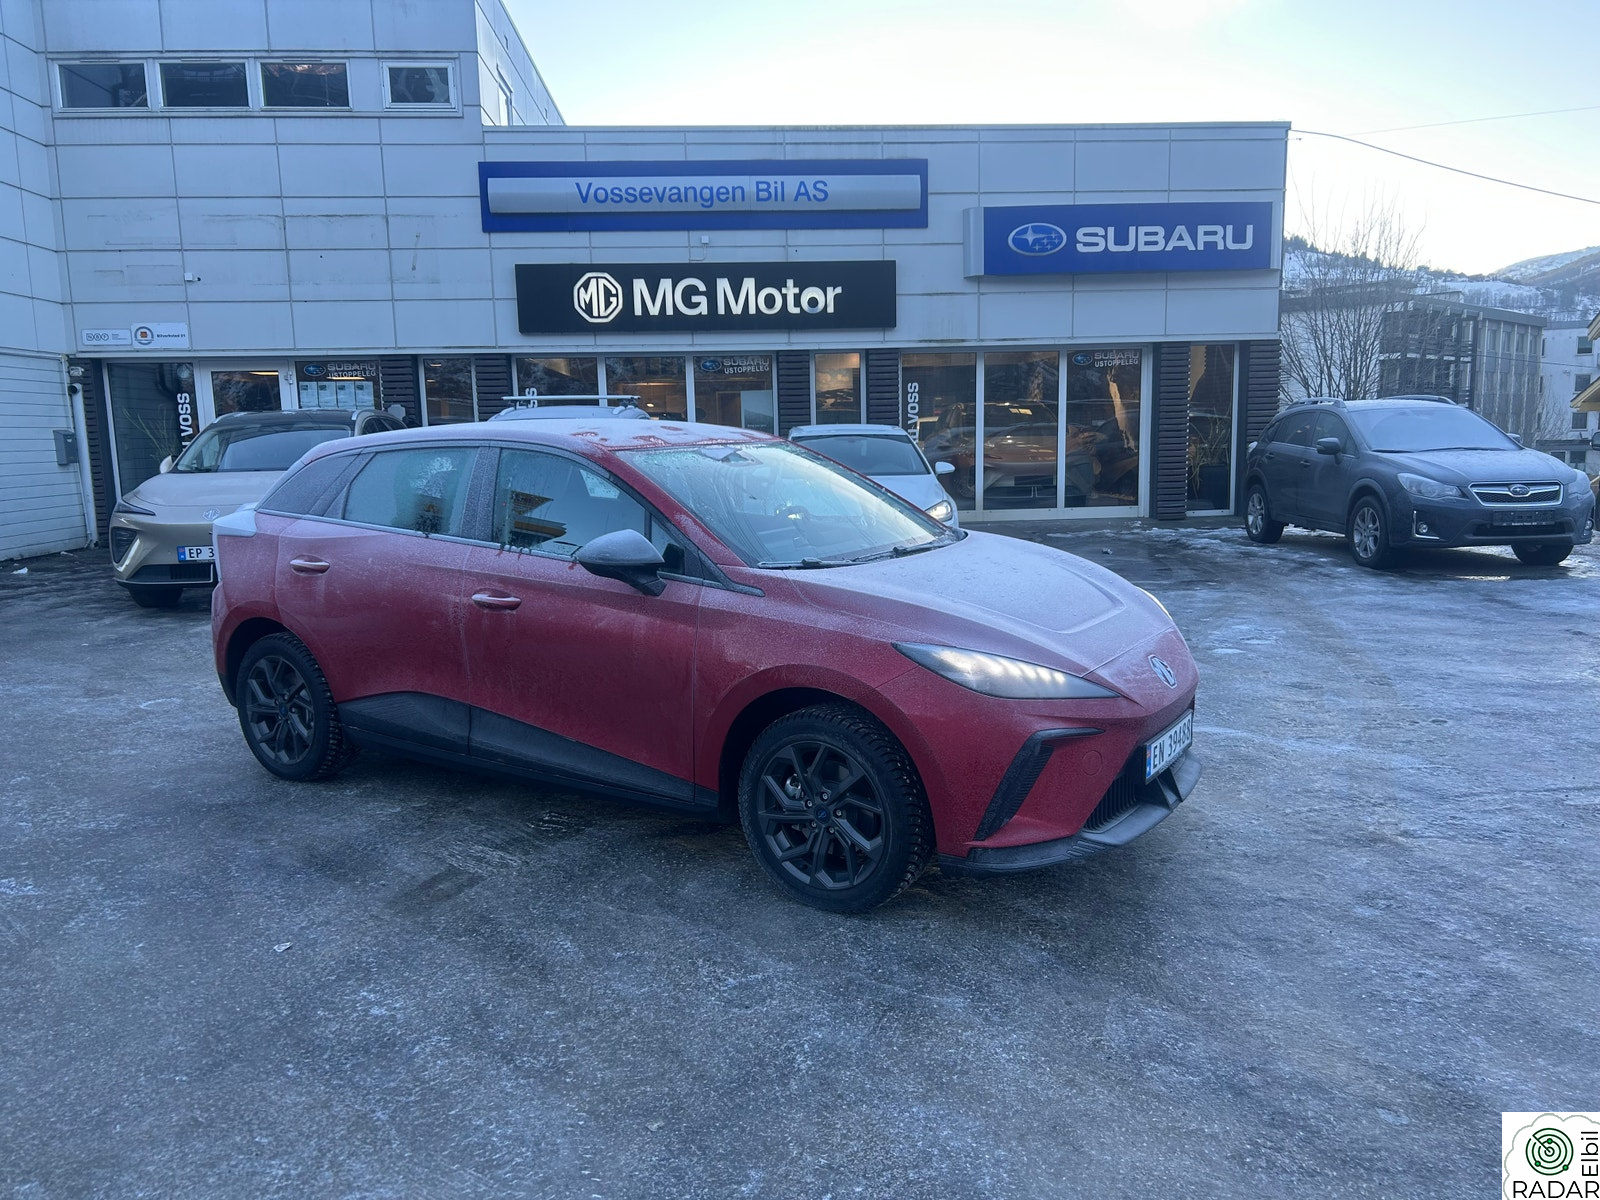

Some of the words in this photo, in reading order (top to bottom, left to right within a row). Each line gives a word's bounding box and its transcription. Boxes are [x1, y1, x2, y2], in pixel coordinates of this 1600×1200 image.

[575, 180, 746, 209] Vossevangen
[755, 179, 786, 202] Bil
[793, 179, 830, 202] AS
[1075, 223, 1254, 253] SUBARU
[632, 277, 709, 317] MG
[716, 276, 843, 316] Motor
[723, 357, 770, 366] SUBARU
[1094, 351, 1139, 360] SUBARU
[1094, 358, 1138, 368] USTOPPELEG
[327, 362, 376, 371] SUBARU
[724, 365, 770, 375] USTOPPELEG
[907, 382, 919, 425] VOSS
[176, 392, 194, 437] VOSS
[188, 548, 203, 559] EP
[1152, 739, 1165, 769] EN
